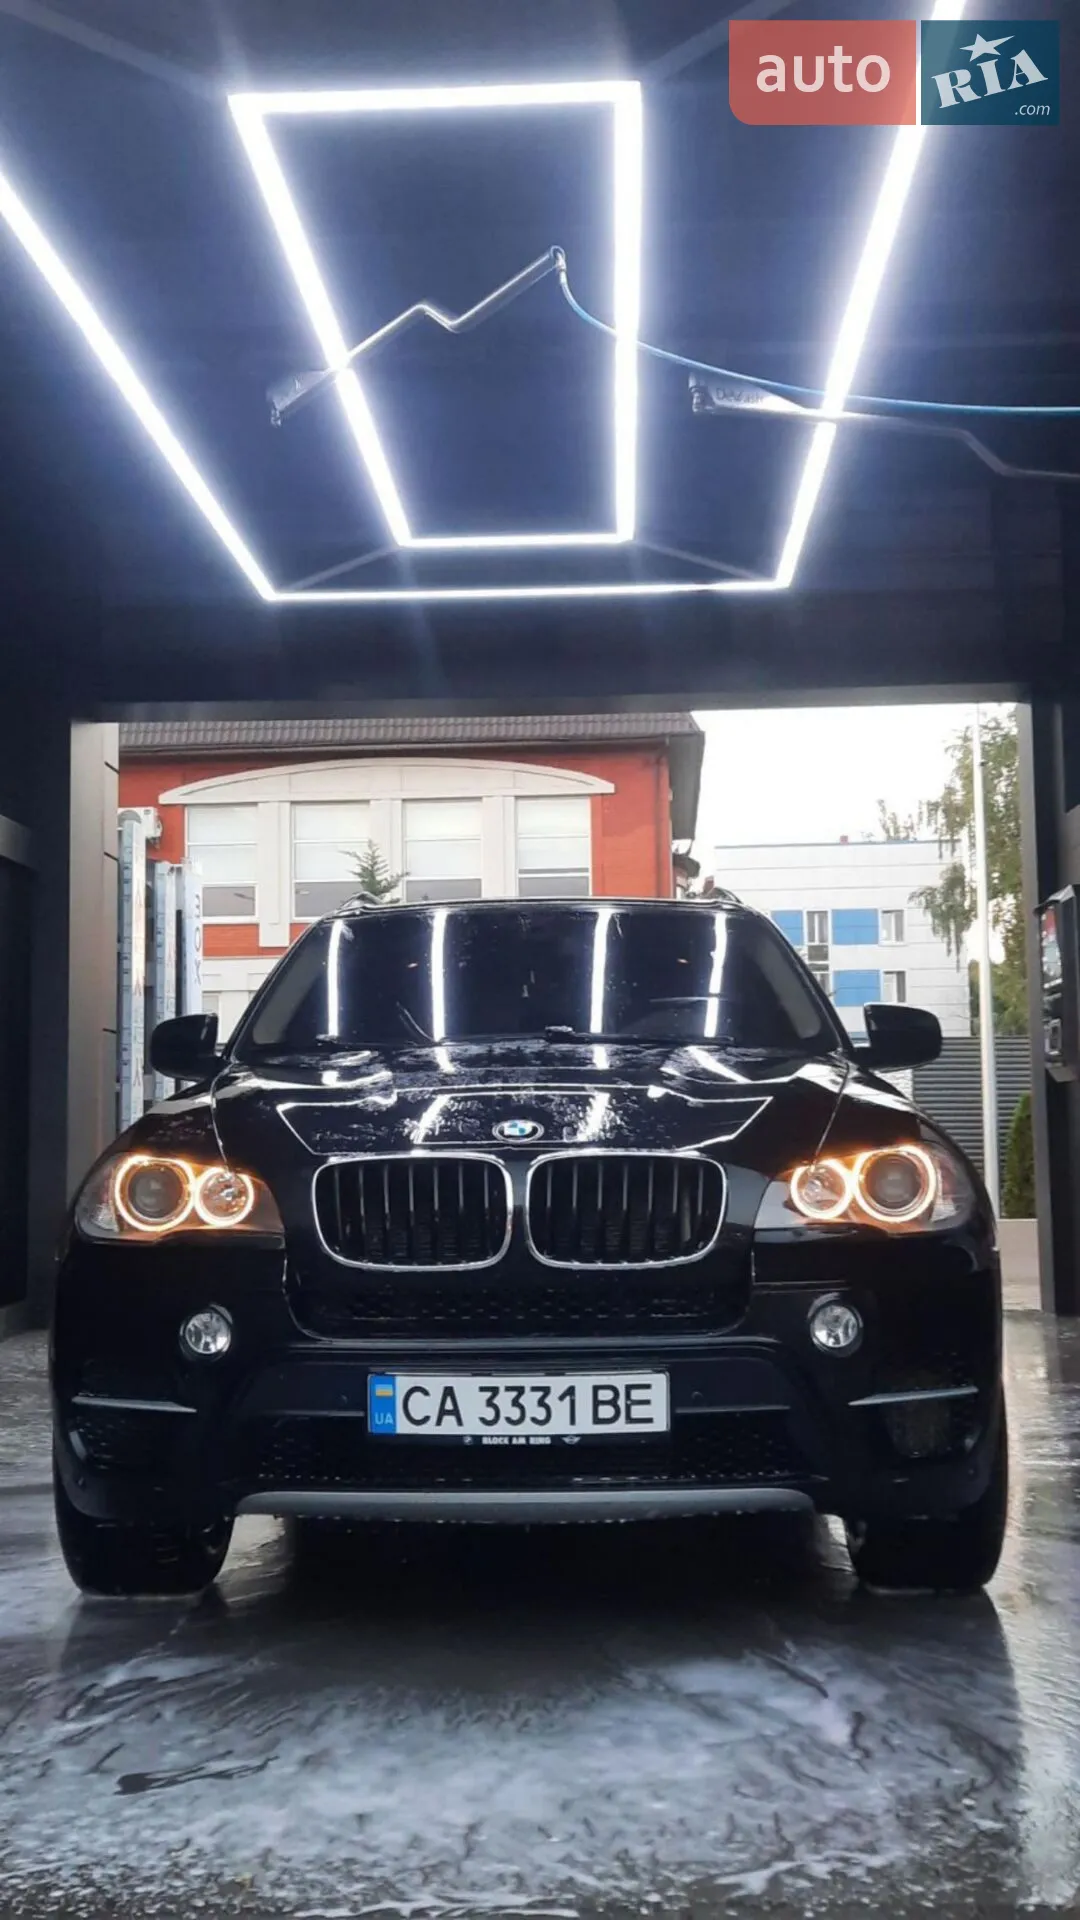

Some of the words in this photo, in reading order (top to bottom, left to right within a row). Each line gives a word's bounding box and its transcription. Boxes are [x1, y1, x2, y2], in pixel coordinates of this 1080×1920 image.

[374, 1411, 394, 1425] UA
[402, 1385, 464, 1427] CA
[478, 1384, 577, 1427] 3331
[591, 1382, 654, 1426] BE
